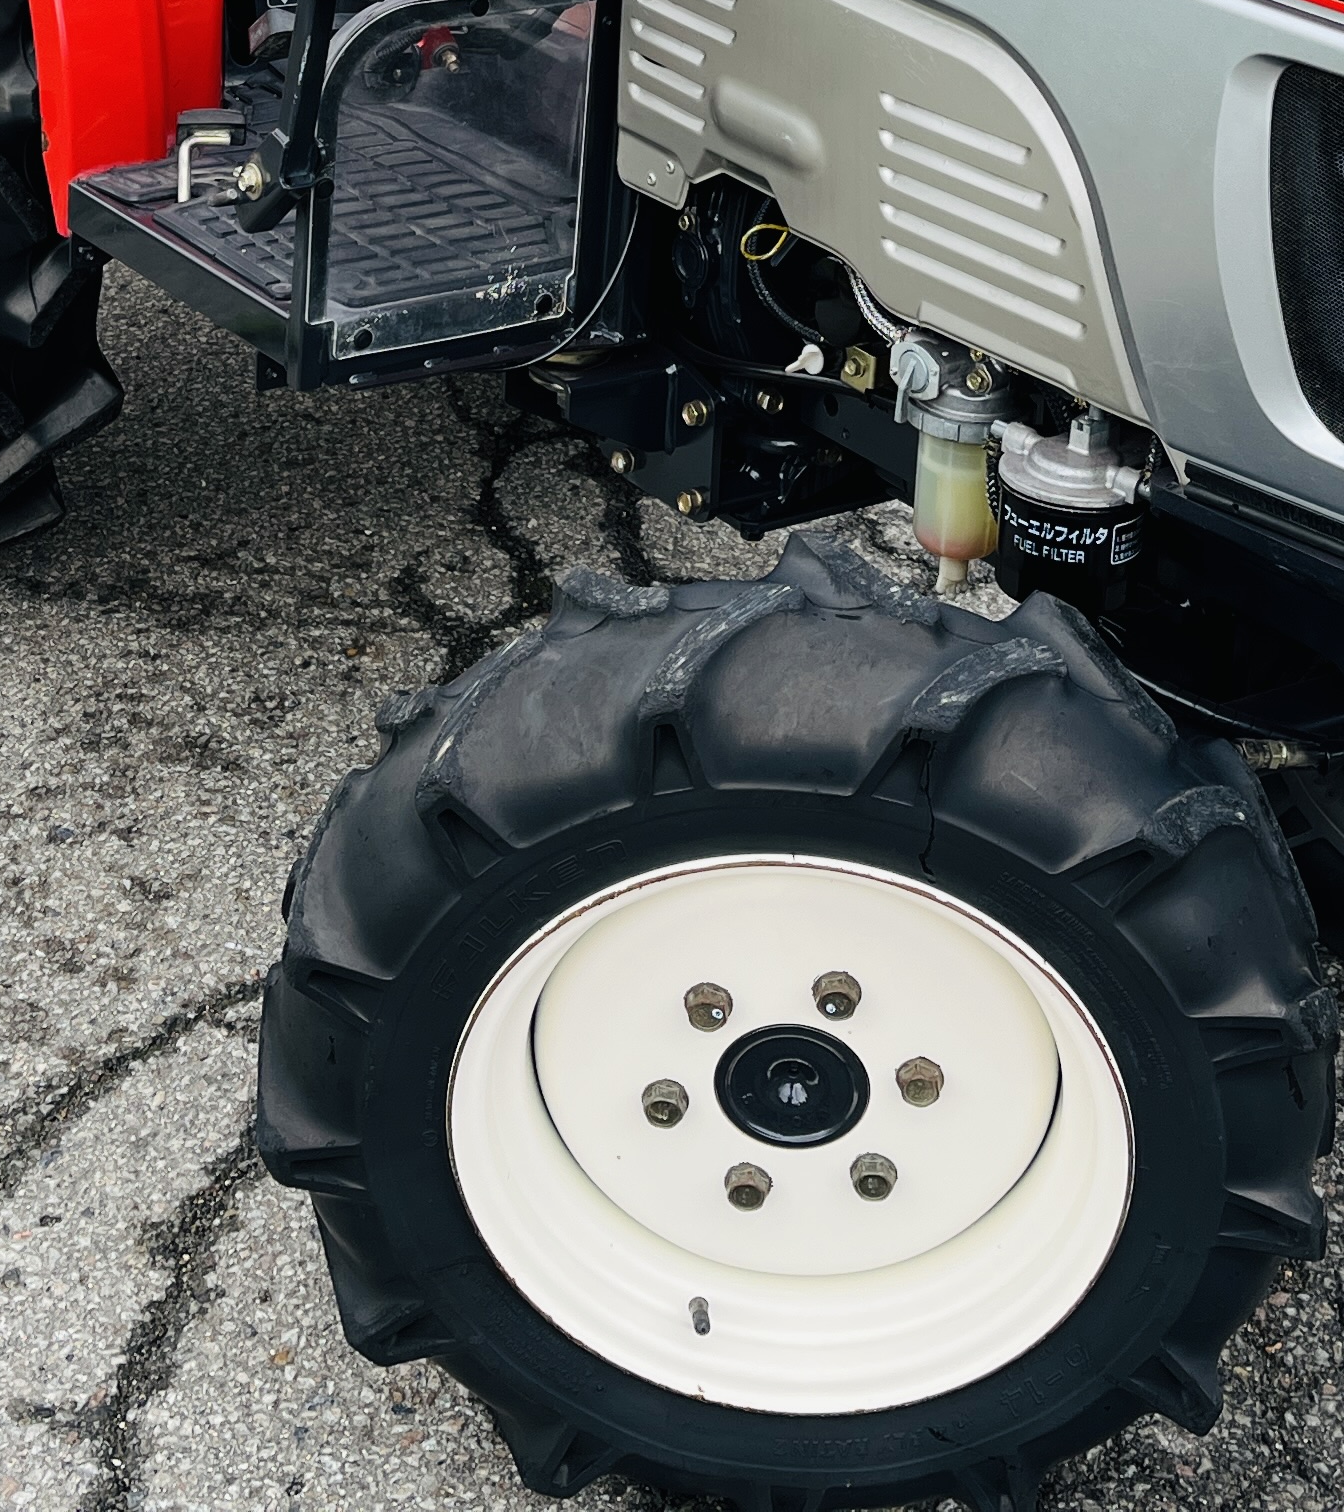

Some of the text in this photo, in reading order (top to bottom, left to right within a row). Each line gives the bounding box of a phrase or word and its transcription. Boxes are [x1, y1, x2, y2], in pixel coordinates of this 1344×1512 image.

[1003, 504, 1109, 546] フューエルフィルタ
[1013, 535, 1085, 564] FUEL FILTER
